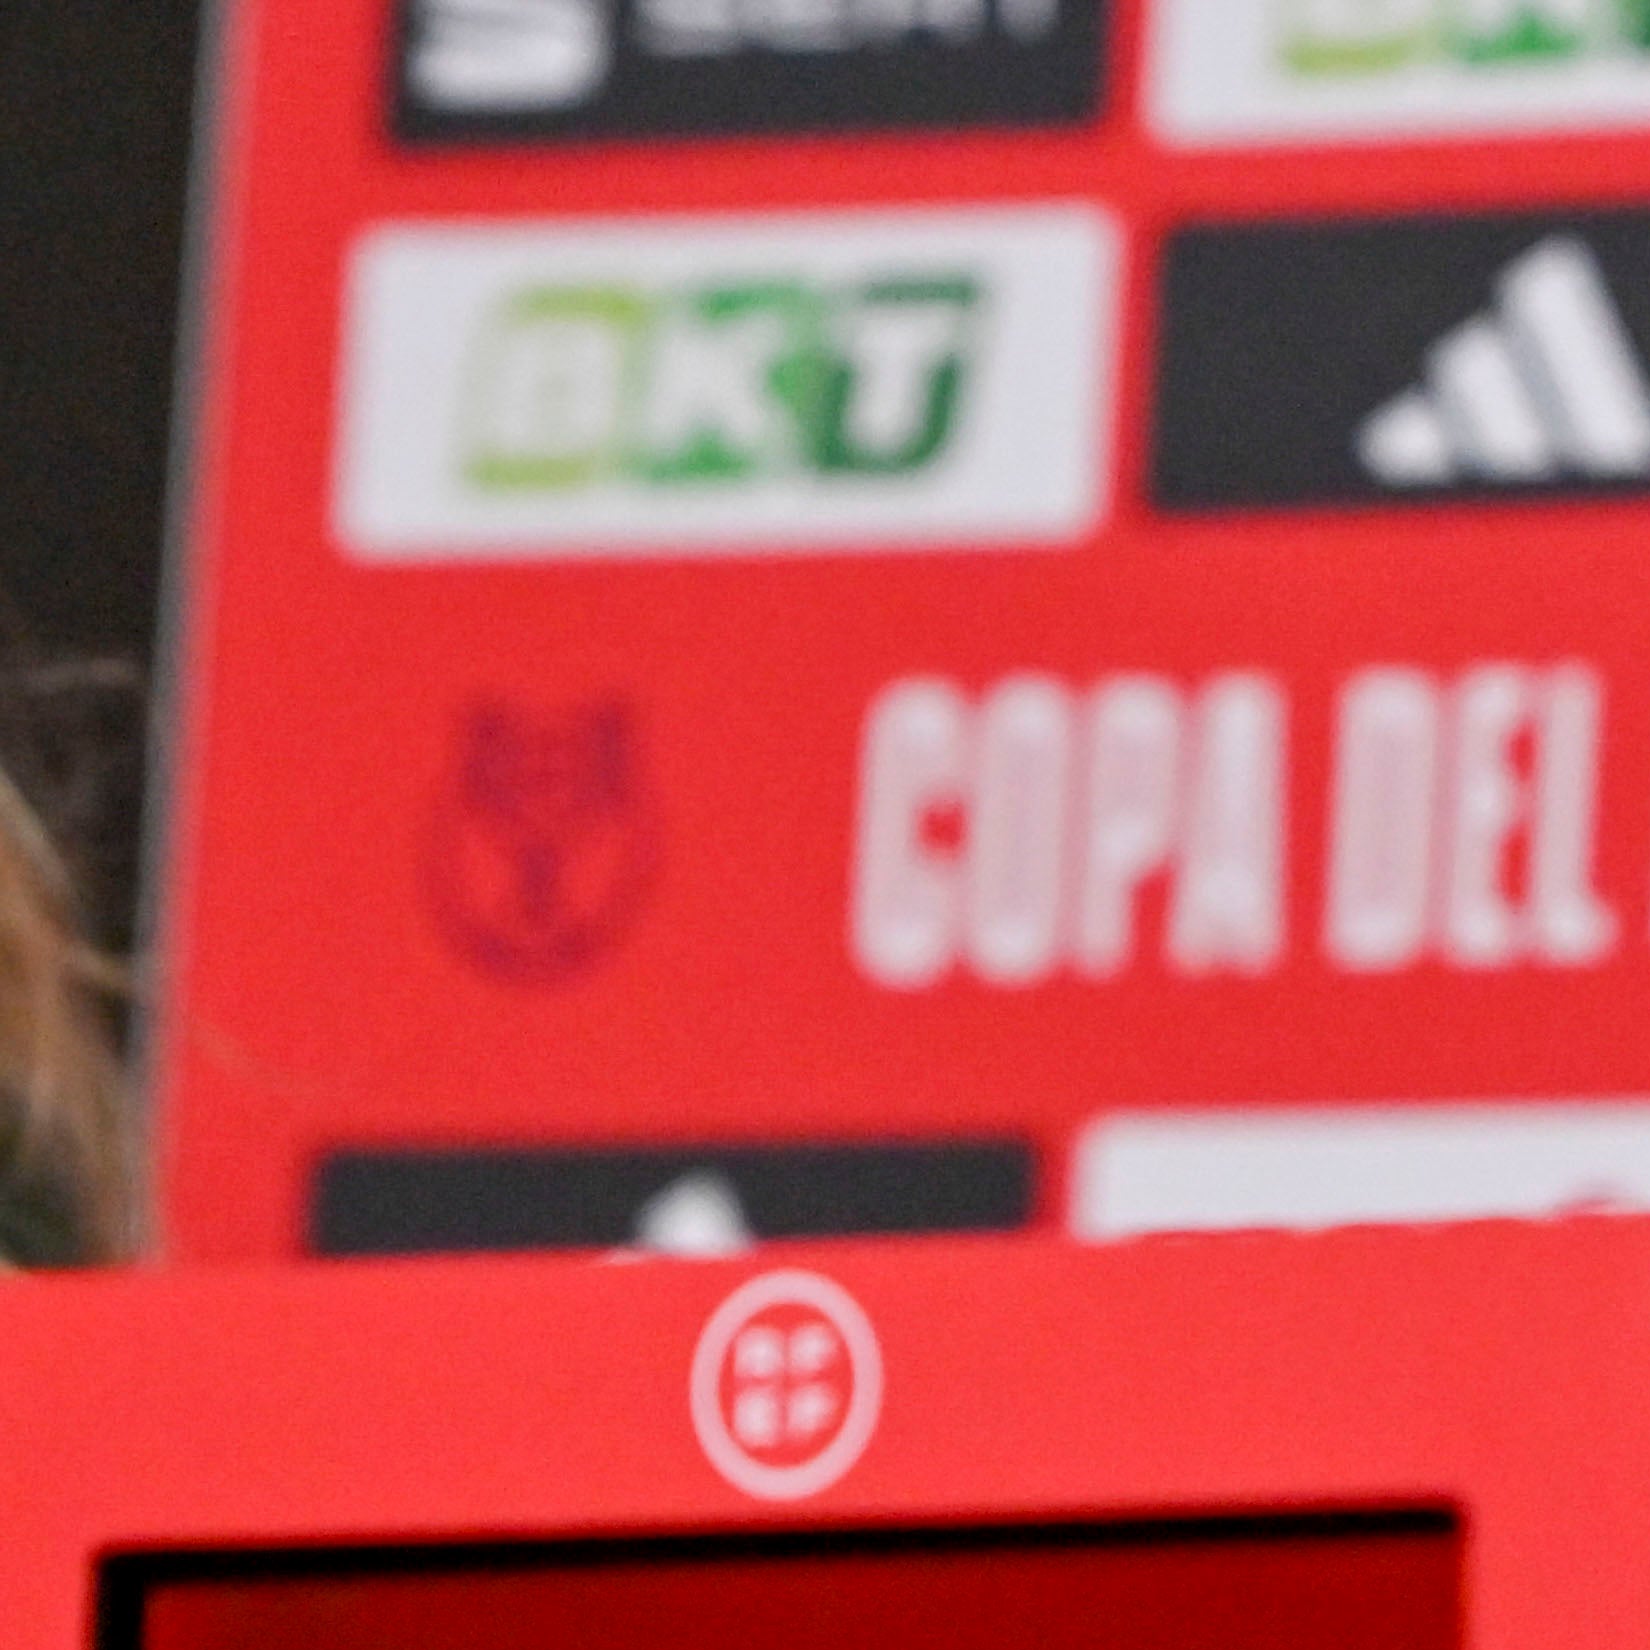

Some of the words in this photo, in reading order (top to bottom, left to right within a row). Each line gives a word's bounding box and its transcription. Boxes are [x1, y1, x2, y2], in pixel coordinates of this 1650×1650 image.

[460, 268, 982, 492] BKT
[850, 670, 1286, 986] COPA
[1323, 656, 1619, 970] DEL
